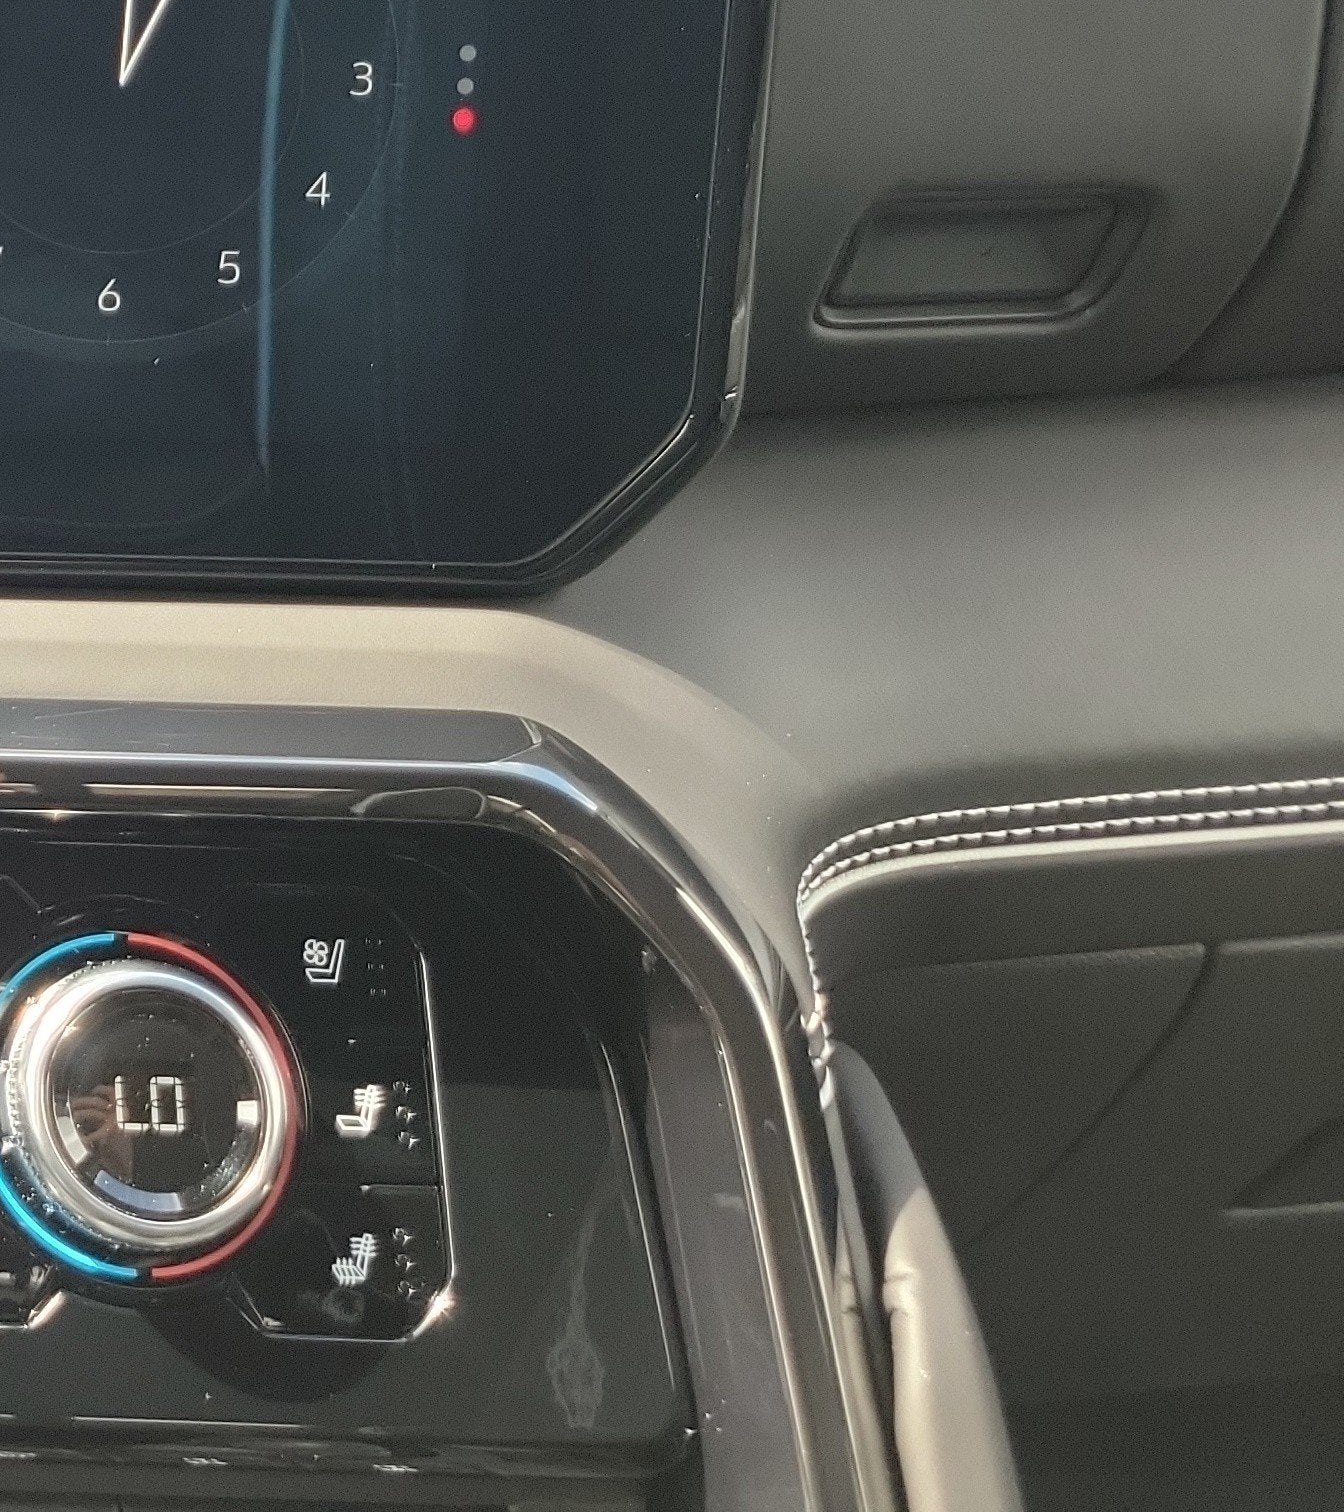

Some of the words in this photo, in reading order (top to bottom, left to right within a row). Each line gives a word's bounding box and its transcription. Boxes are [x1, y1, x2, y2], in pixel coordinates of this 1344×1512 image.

[349, 61, 373, 96] 3
[305, 171, 331, 206] 4
[217, 250, 241, 285] 5
[97, 278, 121, 312] 6
